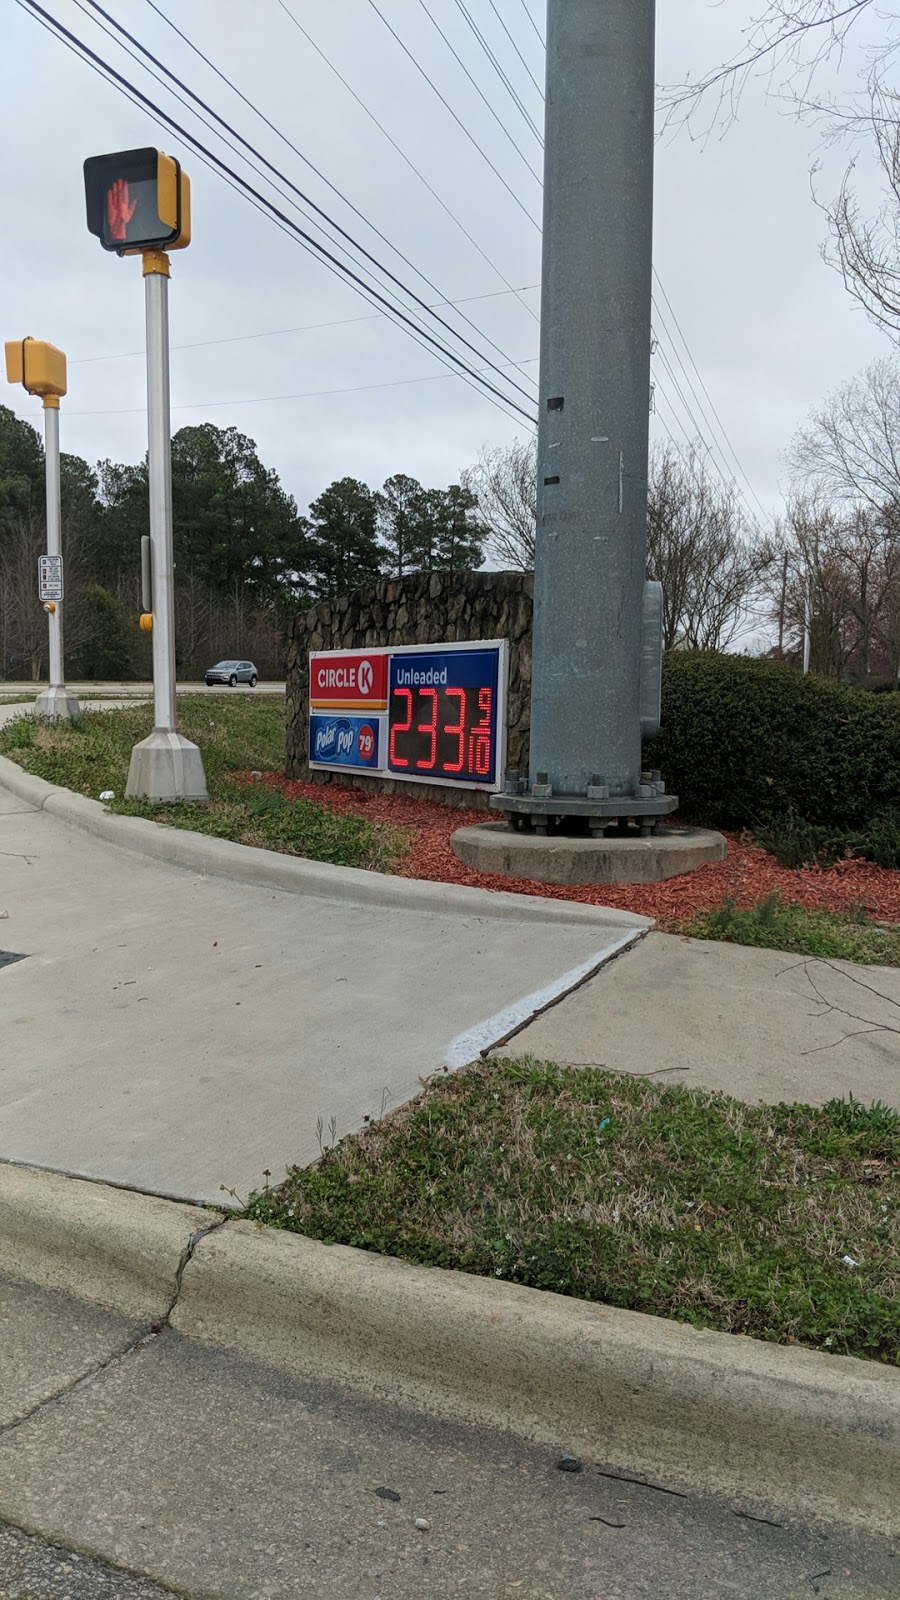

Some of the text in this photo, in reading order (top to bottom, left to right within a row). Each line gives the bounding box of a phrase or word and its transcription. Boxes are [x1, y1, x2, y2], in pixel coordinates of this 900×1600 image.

[318, 663, 372, 693] CIRCLE K
[397, 667, 448, 685] Unleaded
[316, 725, 337, 751] Polar
